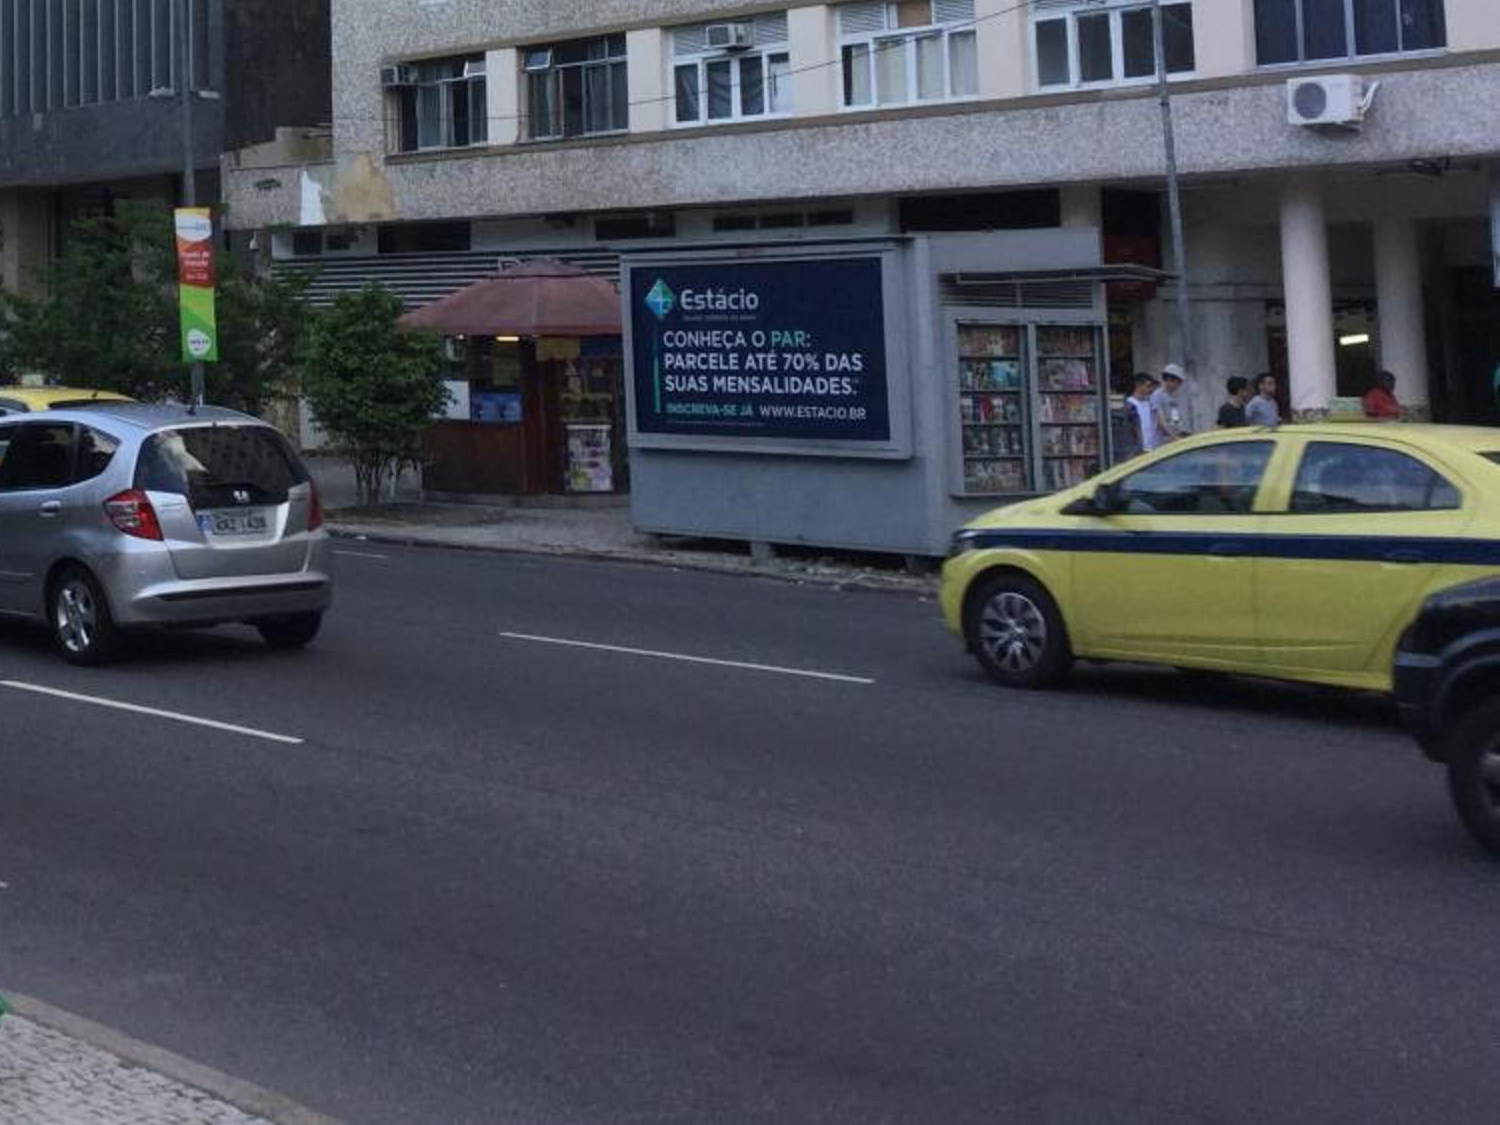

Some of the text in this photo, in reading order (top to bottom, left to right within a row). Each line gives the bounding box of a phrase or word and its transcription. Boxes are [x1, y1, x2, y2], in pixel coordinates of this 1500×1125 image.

[680, 288, 759, 310] Estácio
[663, 330, 811, 350] CONHEÇA O PAR:
[664, 348, 863, 371] PARCELE ATÉ 70% DAS
[665, 375, 857, 395] SUAS MENSALIDADES.
